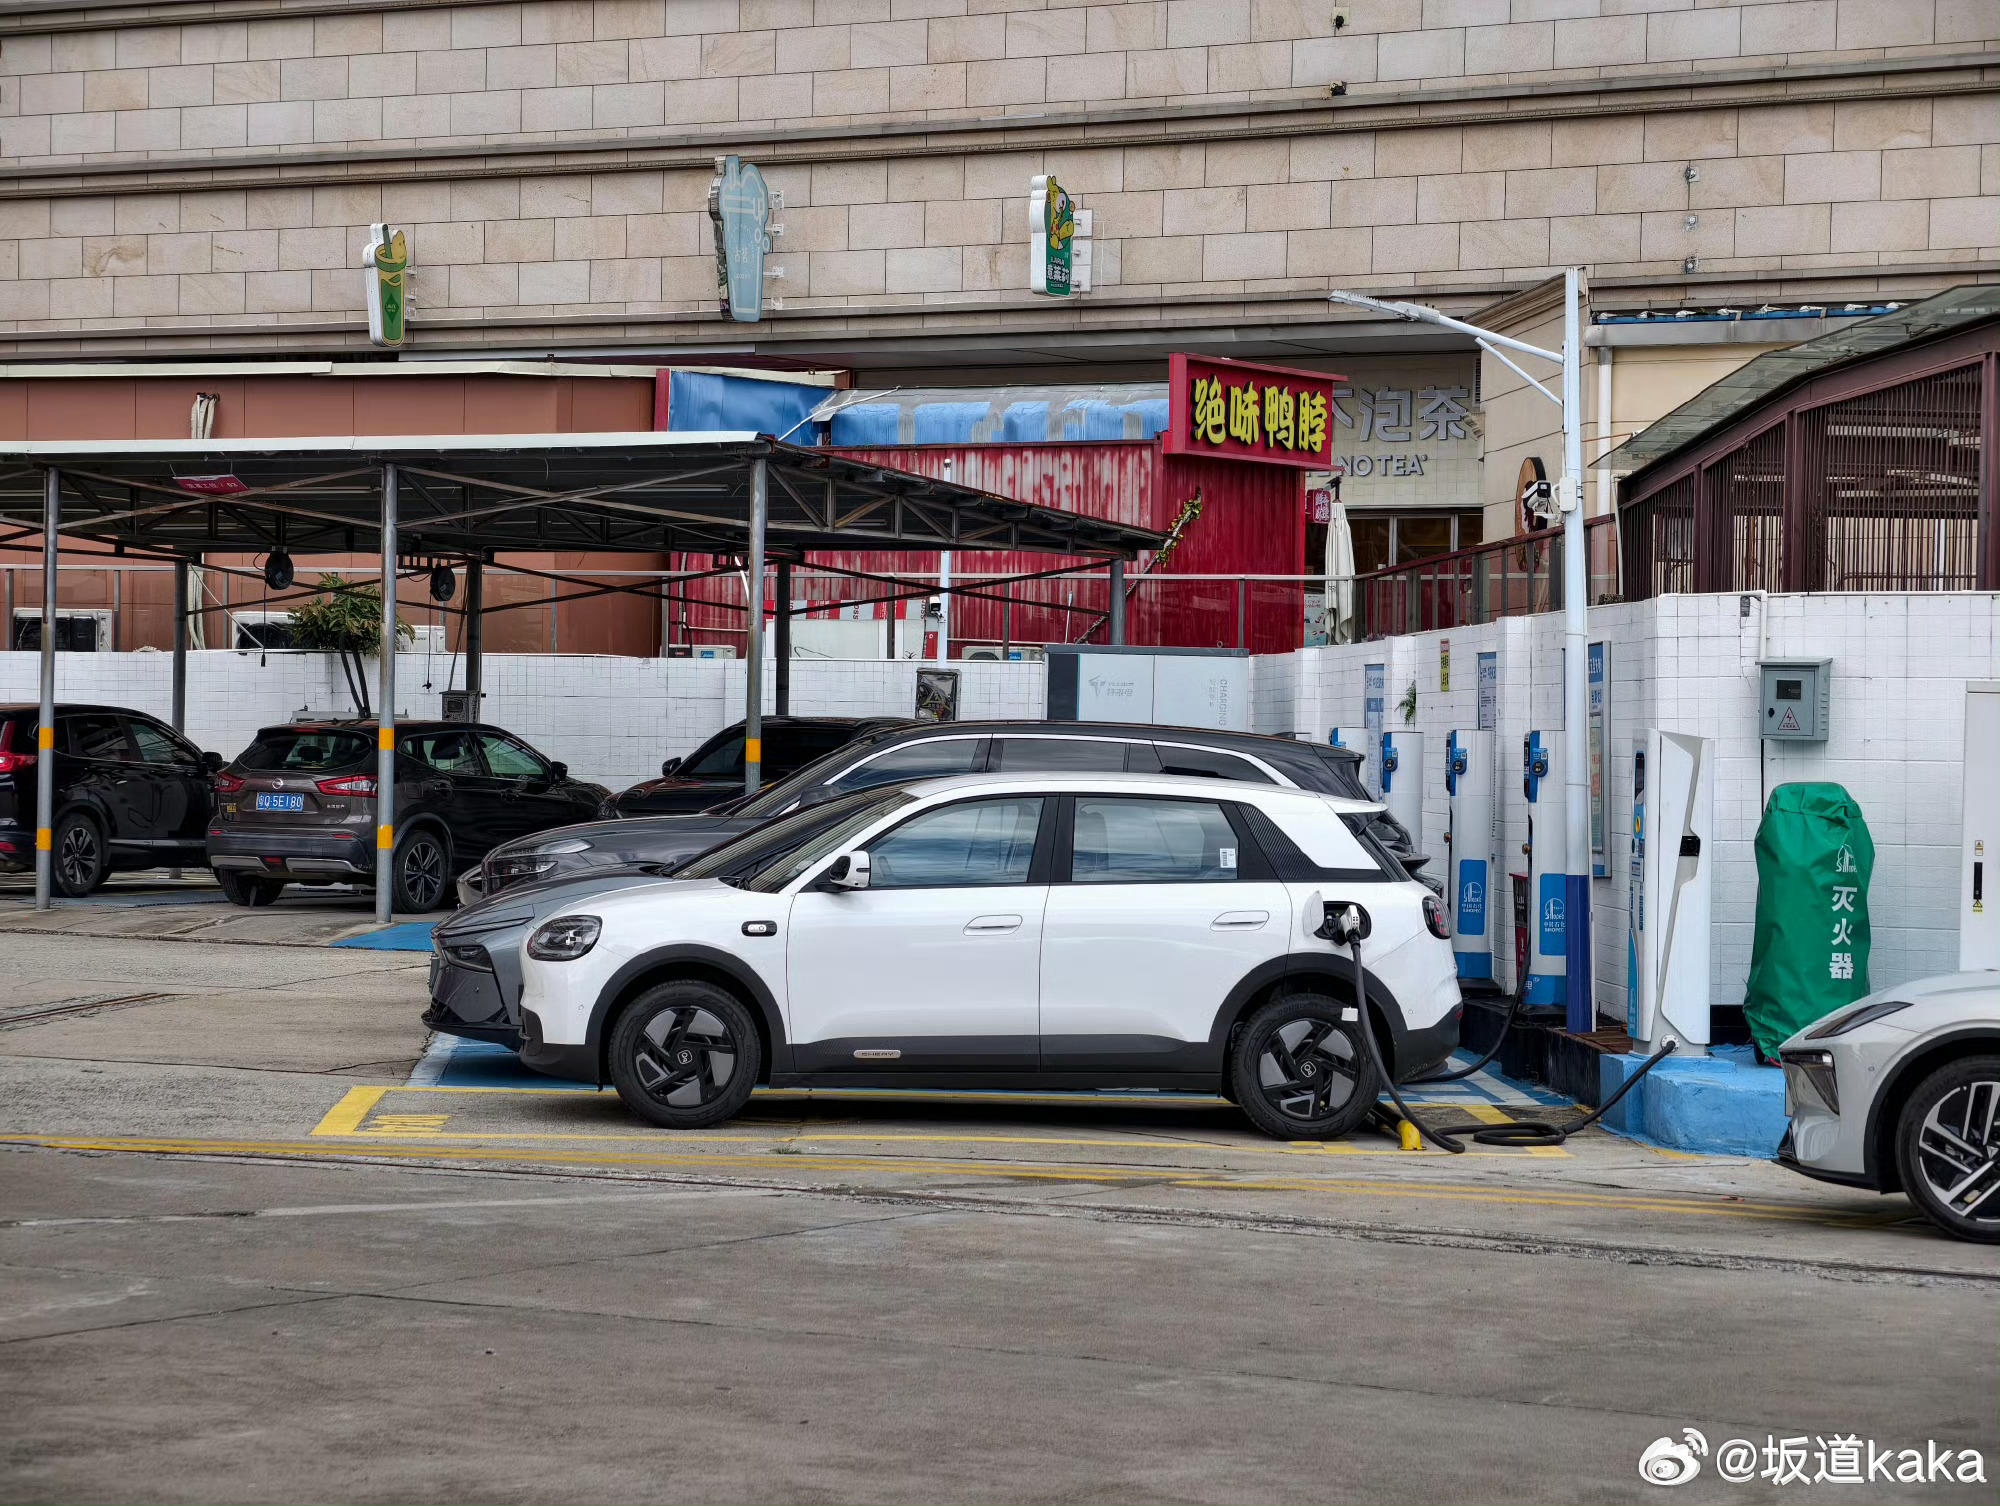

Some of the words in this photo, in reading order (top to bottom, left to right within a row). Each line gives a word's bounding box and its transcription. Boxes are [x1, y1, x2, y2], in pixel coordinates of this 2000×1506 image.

[1193, 373, 1328, 453] 绝味鸭脖
[1218, 679, 1228, 726] CHARGING
[1829, 886, 1858, 979] 灭火器
